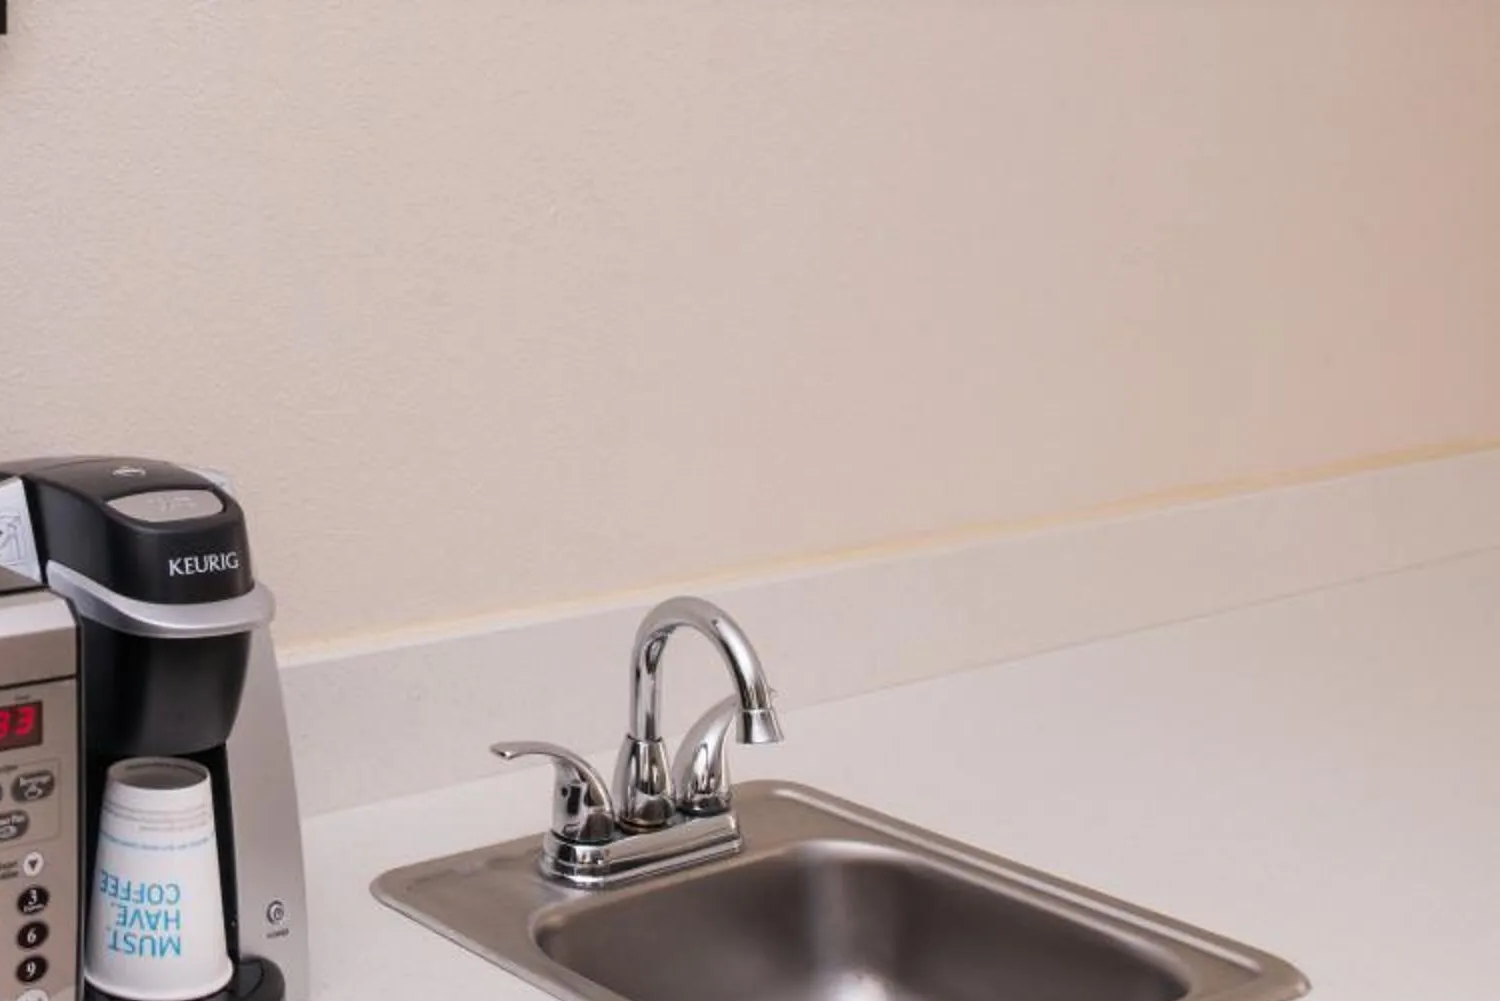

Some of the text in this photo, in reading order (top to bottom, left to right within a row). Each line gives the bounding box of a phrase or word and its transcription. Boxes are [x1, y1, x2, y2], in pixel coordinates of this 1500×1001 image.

[169, 552, 239, 577] KEURIG
[100, 868, 181, 905] COFFEE
[28, 889, 38, 905] 3
[26, 927, 38, 944] 6
[25, 960, 37, 978] 9
